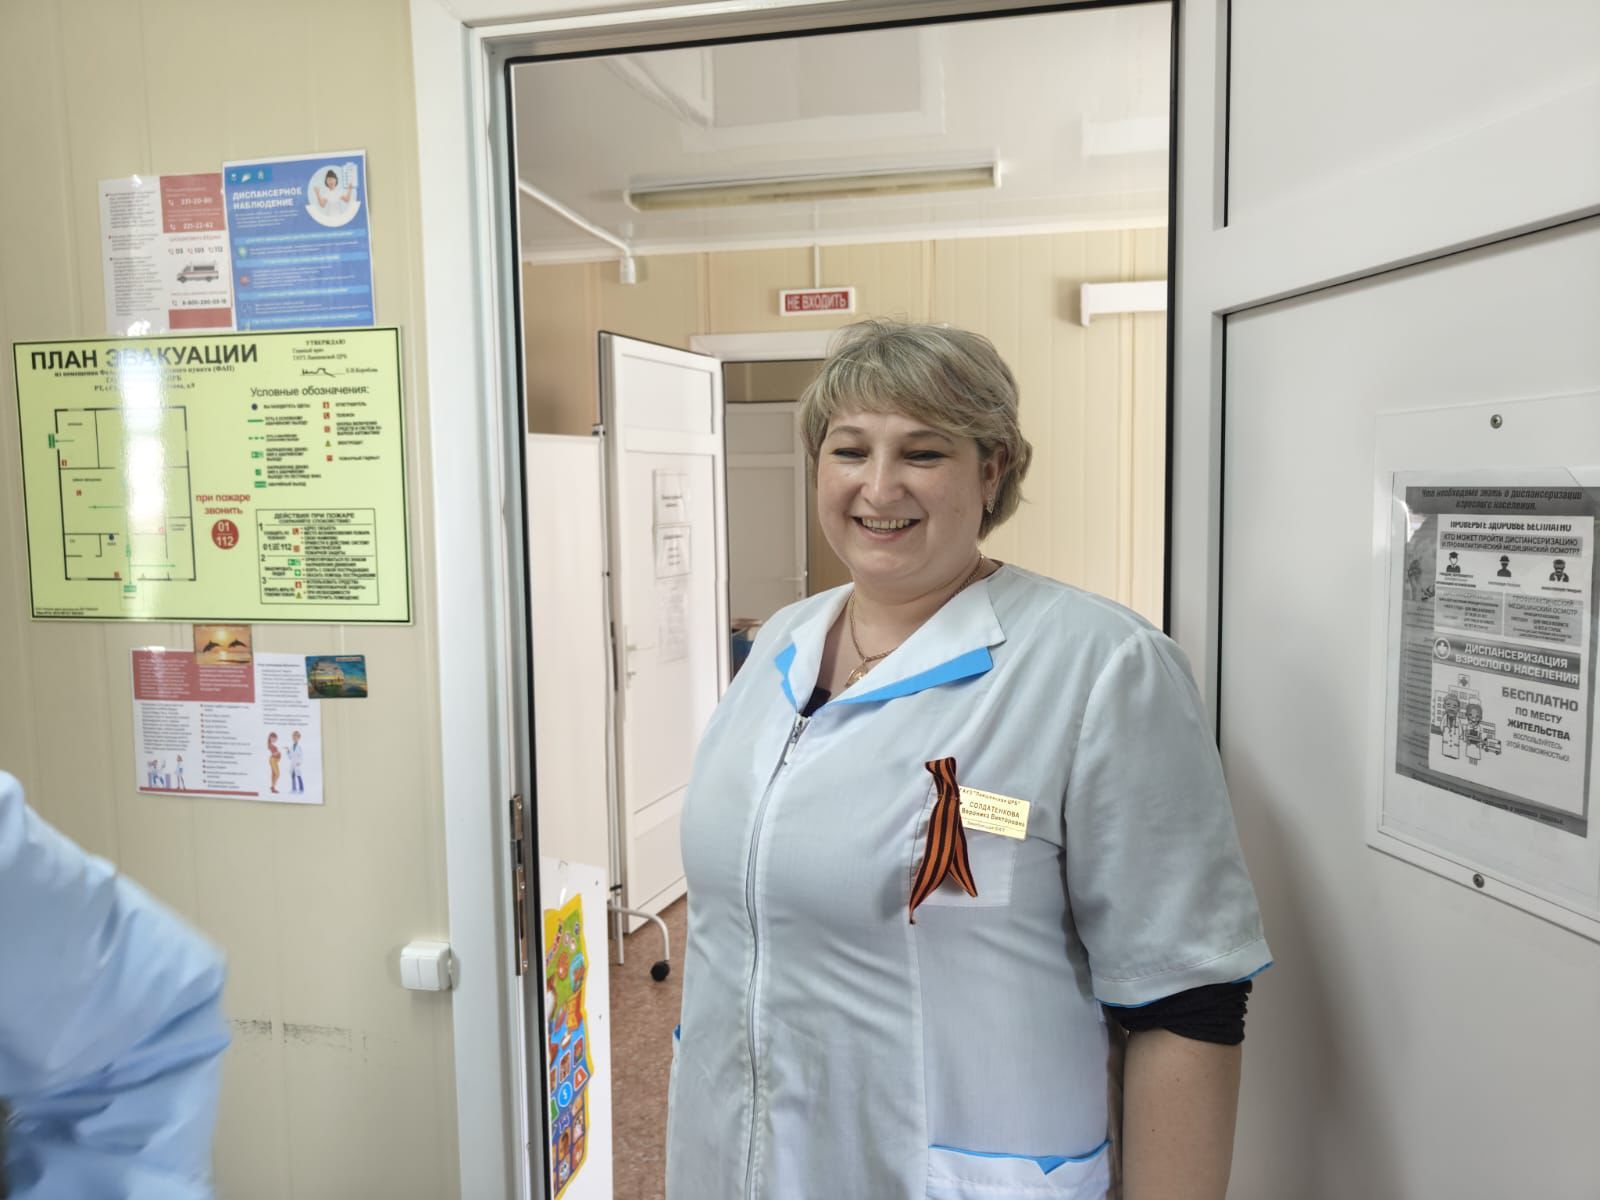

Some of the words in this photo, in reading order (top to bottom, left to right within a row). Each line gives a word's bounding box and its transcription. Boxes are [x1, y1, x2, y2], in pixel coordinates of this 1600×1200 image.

[232, 186, 304, 200] ДИСПАНСЕРНОЕ
[233, 198, 294, 210] НАБЛЮДЕНИЕ
[786, 294, 801, 310] НЕ
[801, 292, 847, 310] ВХОДИТЬ
[31, 349, 98, 370] ПЛАН
[105, 344, 258, 368] ЭВАКУАЦИИ
[250, 386, 300, 398] Условные
[302, 384, 371, 396] обозначения:
[196, 494, 213, 504] при
[215, 494, 251, 504] пожаре
[1510, 489, 1583, 501] диспансеризации
[205, 507, 243, 515] звонить
[218, 521, 230, 532] 01
[216, 535, 234, 547] 112
[1443, 533, 1456, 541] КТО
[1456, 533, 1478, 542] МОЖЕТ
[1478, 534, 1504, 543] ПРОЙТИ
[1504, 535, 1578, 547] ДИСПАНСЕРИЗАЦИЮ
[1464, 643, 1568, 669] ДИСПАНСЕРИЗАЦИЯ
[1455, 654, 1511, 673] ВЗРОСЛОГО
[1513, 664, 1579, 684] НАСЕЛЕНИЯ
[1501, 686, 1579, 712] БЕСПЛАТНО
[1515, 706, 1528, 717] ПО
[1530, 709, 1562, 724] МЕСТУ
[1507, 718, 1570, 741] ЖИТЕЛЬСТВА
[961, 807, 990, 819] Вероника
[990, 813, 1026, 828] Викторовна
[969, 801, 1020, 819] СОЛДАТЕНКОВА
